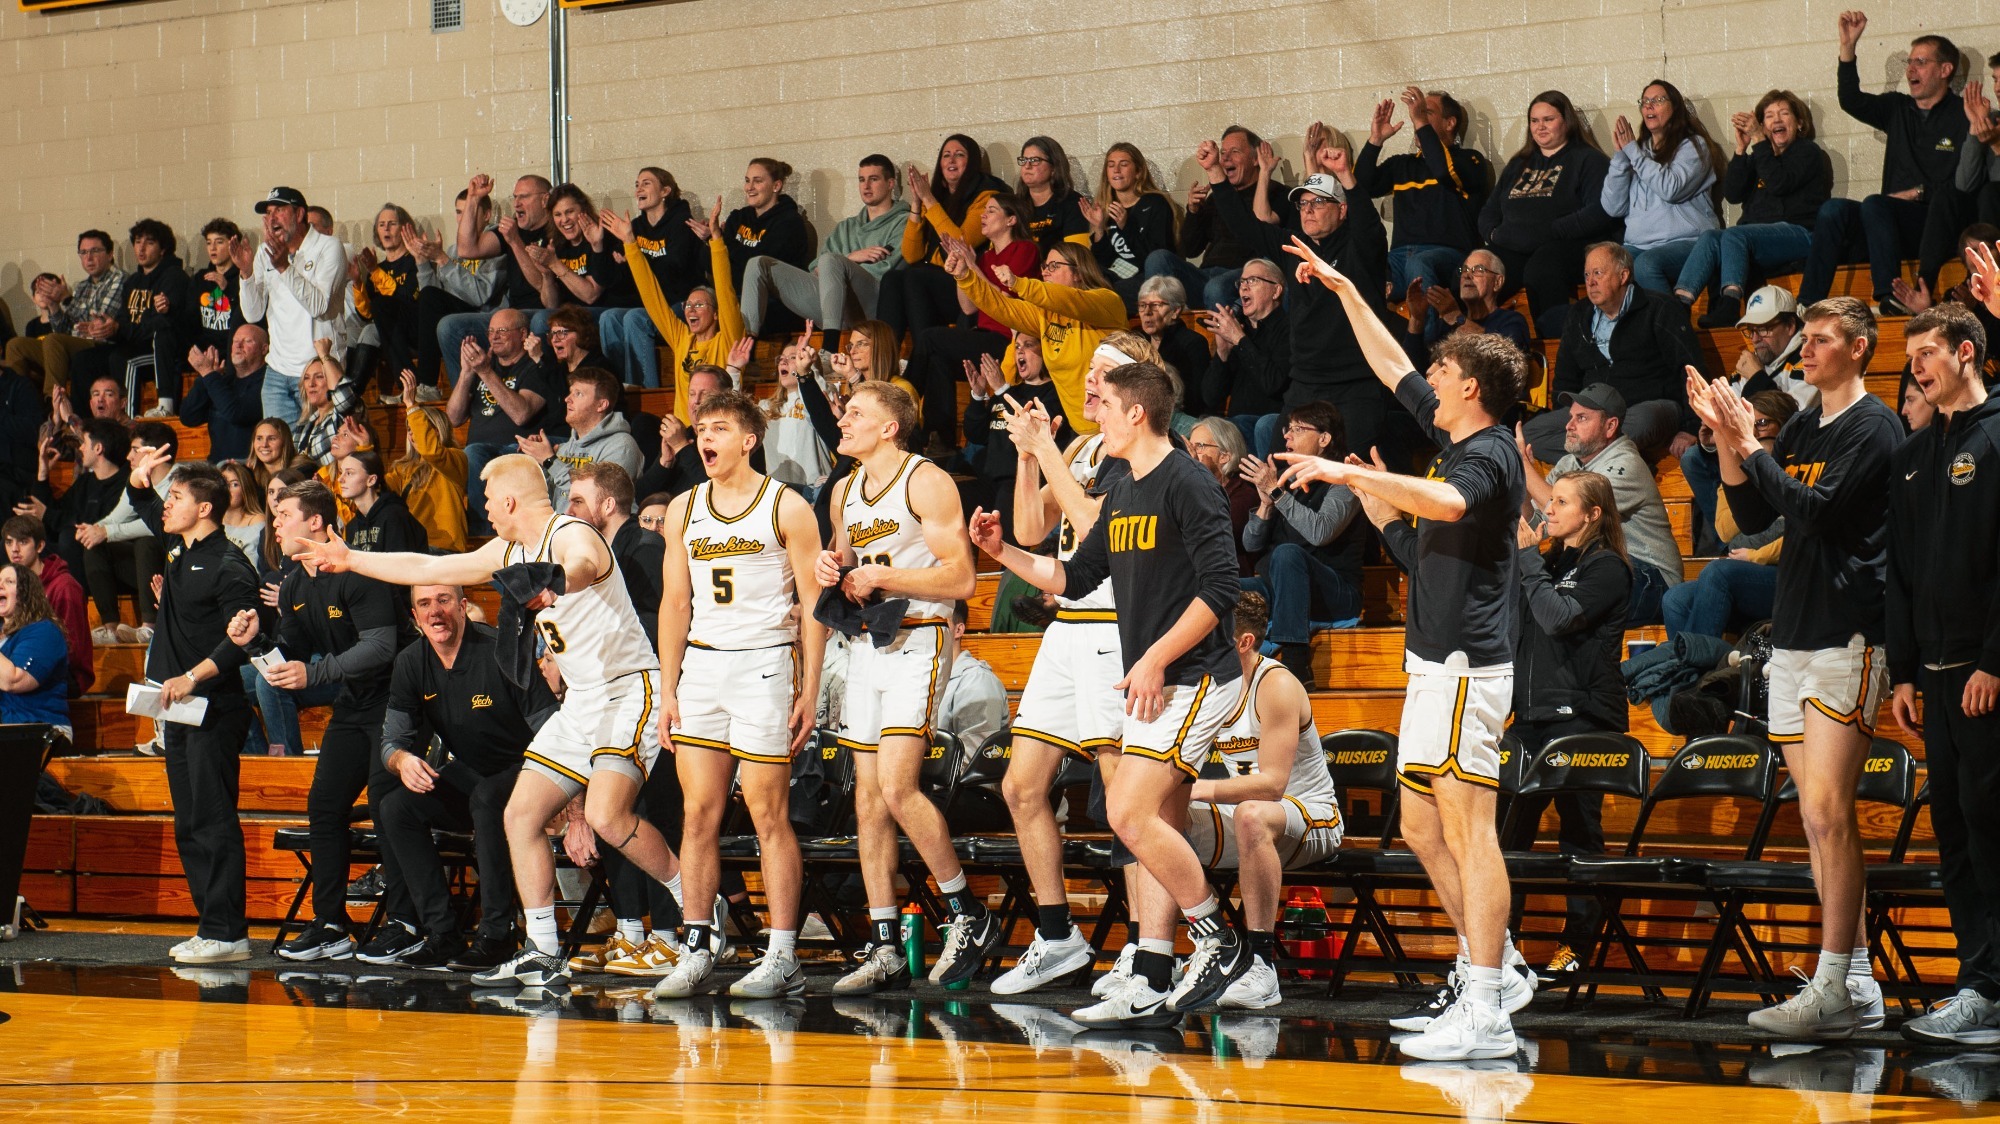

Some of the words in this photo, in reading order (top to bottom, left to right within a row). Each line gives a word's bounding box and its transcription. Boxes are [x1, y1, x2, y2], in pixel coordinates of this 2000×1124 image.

[847, 518, 900, 549] Huskies
[1109, 515, 1158, 553] MTU
[690, 536, 766, 562] Huskies
[712, 568, 734, 605] 5
[471, 694, 494, 710] Tech
[1336, 751, 1388, 764] HUSKIES
[1571, 753, 1629, 766] HUSKIES
[1704, 754, 1760, 770] HUSKIES
